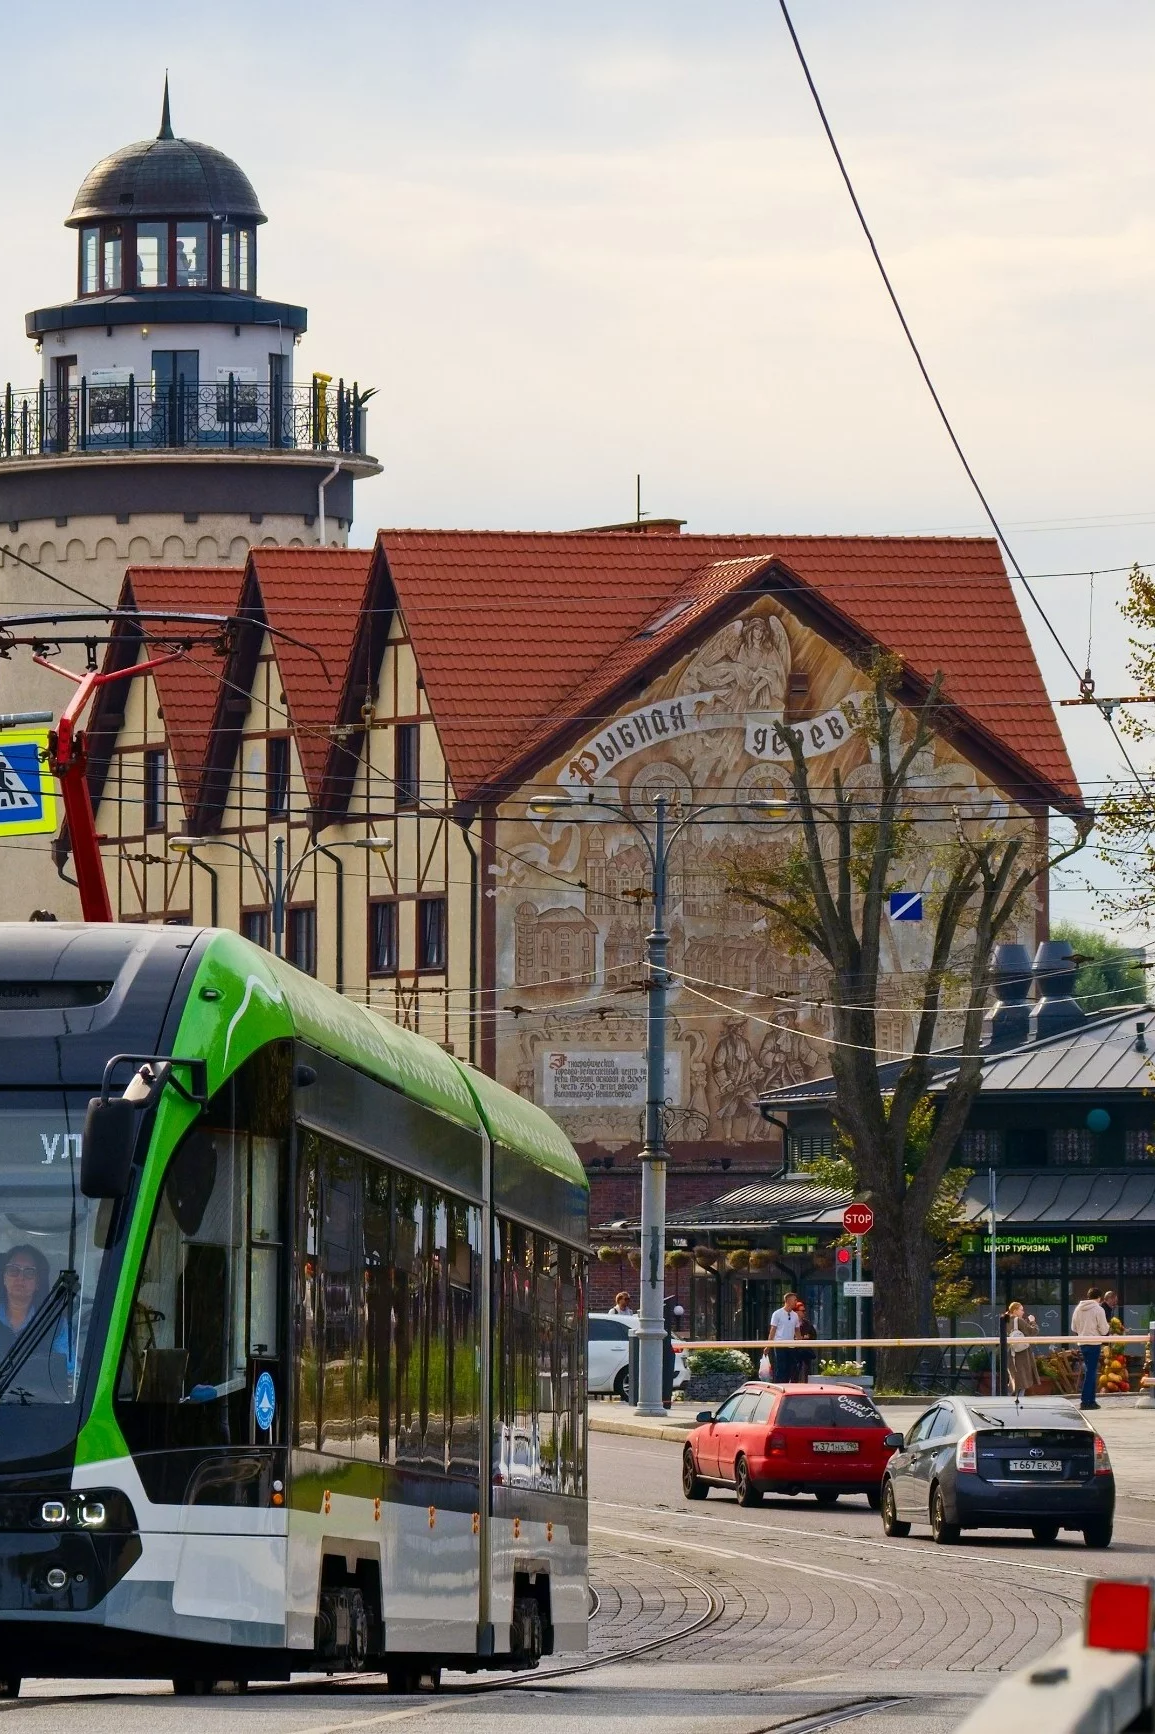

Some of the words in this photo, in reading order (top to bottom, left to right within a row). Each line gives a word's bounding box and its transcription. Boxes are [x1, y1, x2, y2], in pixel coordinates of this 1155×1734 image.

[569, 701, 687, 785] Рыбная
[627, 1075, 647, 1083] 2005
[845, 1214, 872, 1224] STOP
[983, 1235, 1067, 1244] ИНФОРМАЦИОННЫЙ
[1076, 1235, 1108, 1243] TOURIST
[1012, 1244, 1051, 1252] ТУРИЗМА
[1075, 1244, 1095, 1252] INFO
[1013, 1460, 1048, 1470] Т667ЕК
[1050, 1460, 1059, 1469] 39
